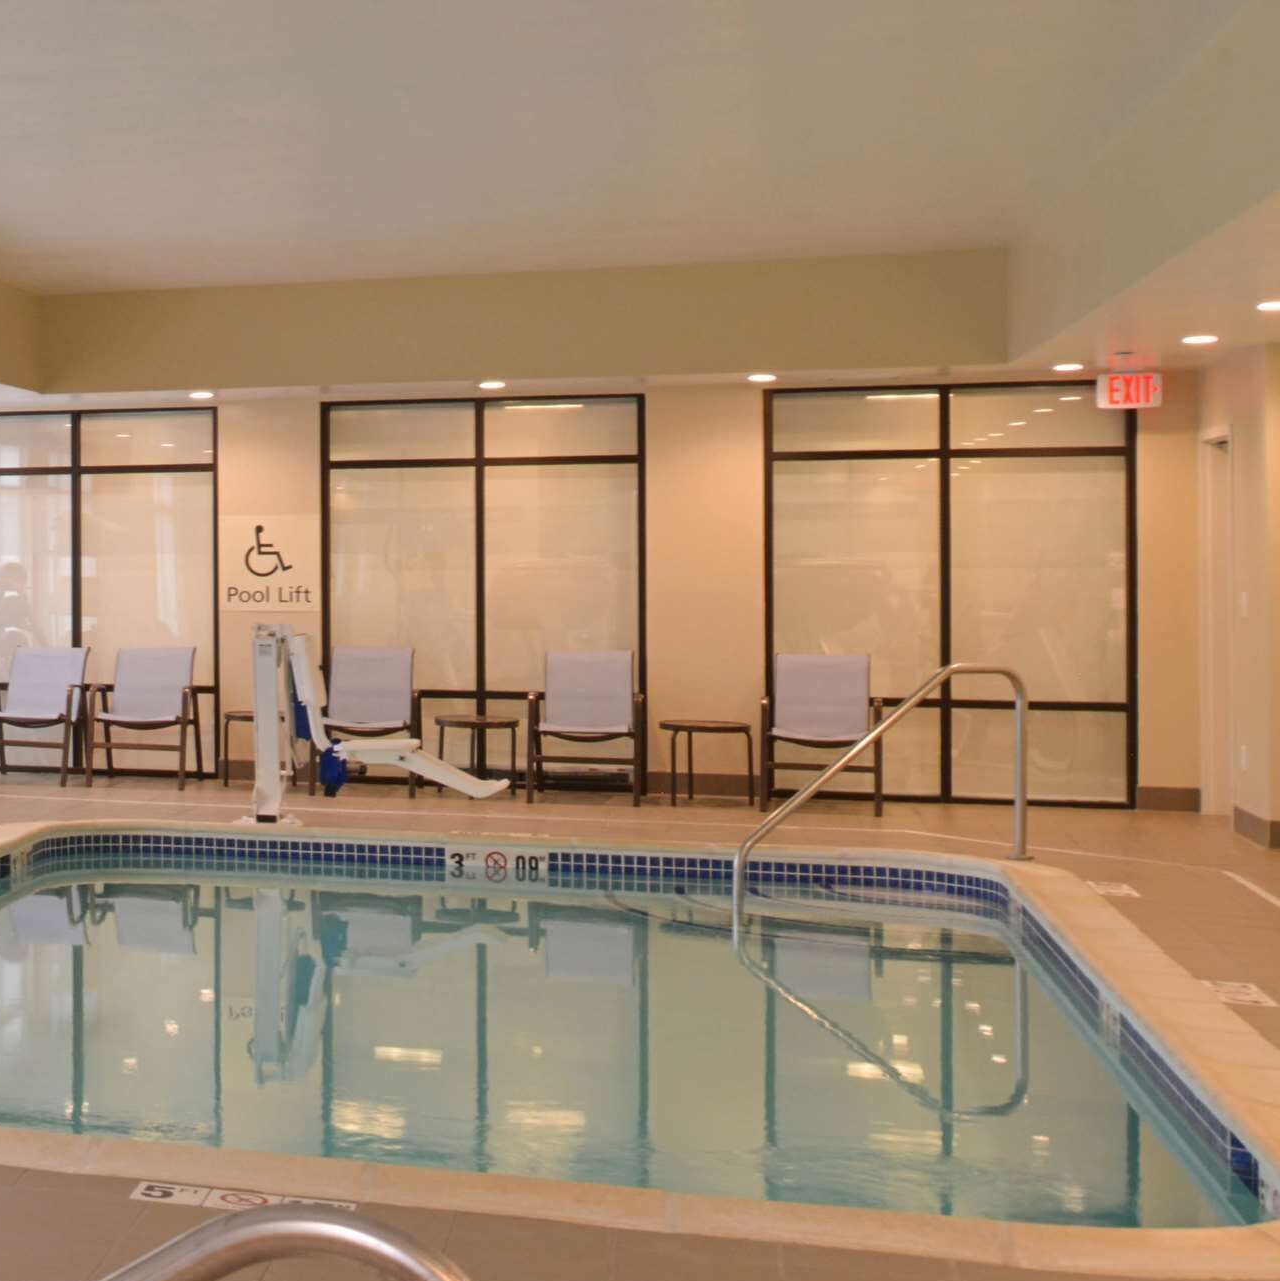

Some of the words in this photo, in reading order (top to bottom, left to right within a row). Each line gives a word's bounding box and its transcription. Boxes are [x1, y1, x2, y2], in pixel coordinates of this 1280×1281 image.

[1108, 374, 1153, 405] EXIT
[227, 585, 270, 603] Pool
[278, 585, 312, 603] Lift
[141, 1184, 175, 1199] 5
